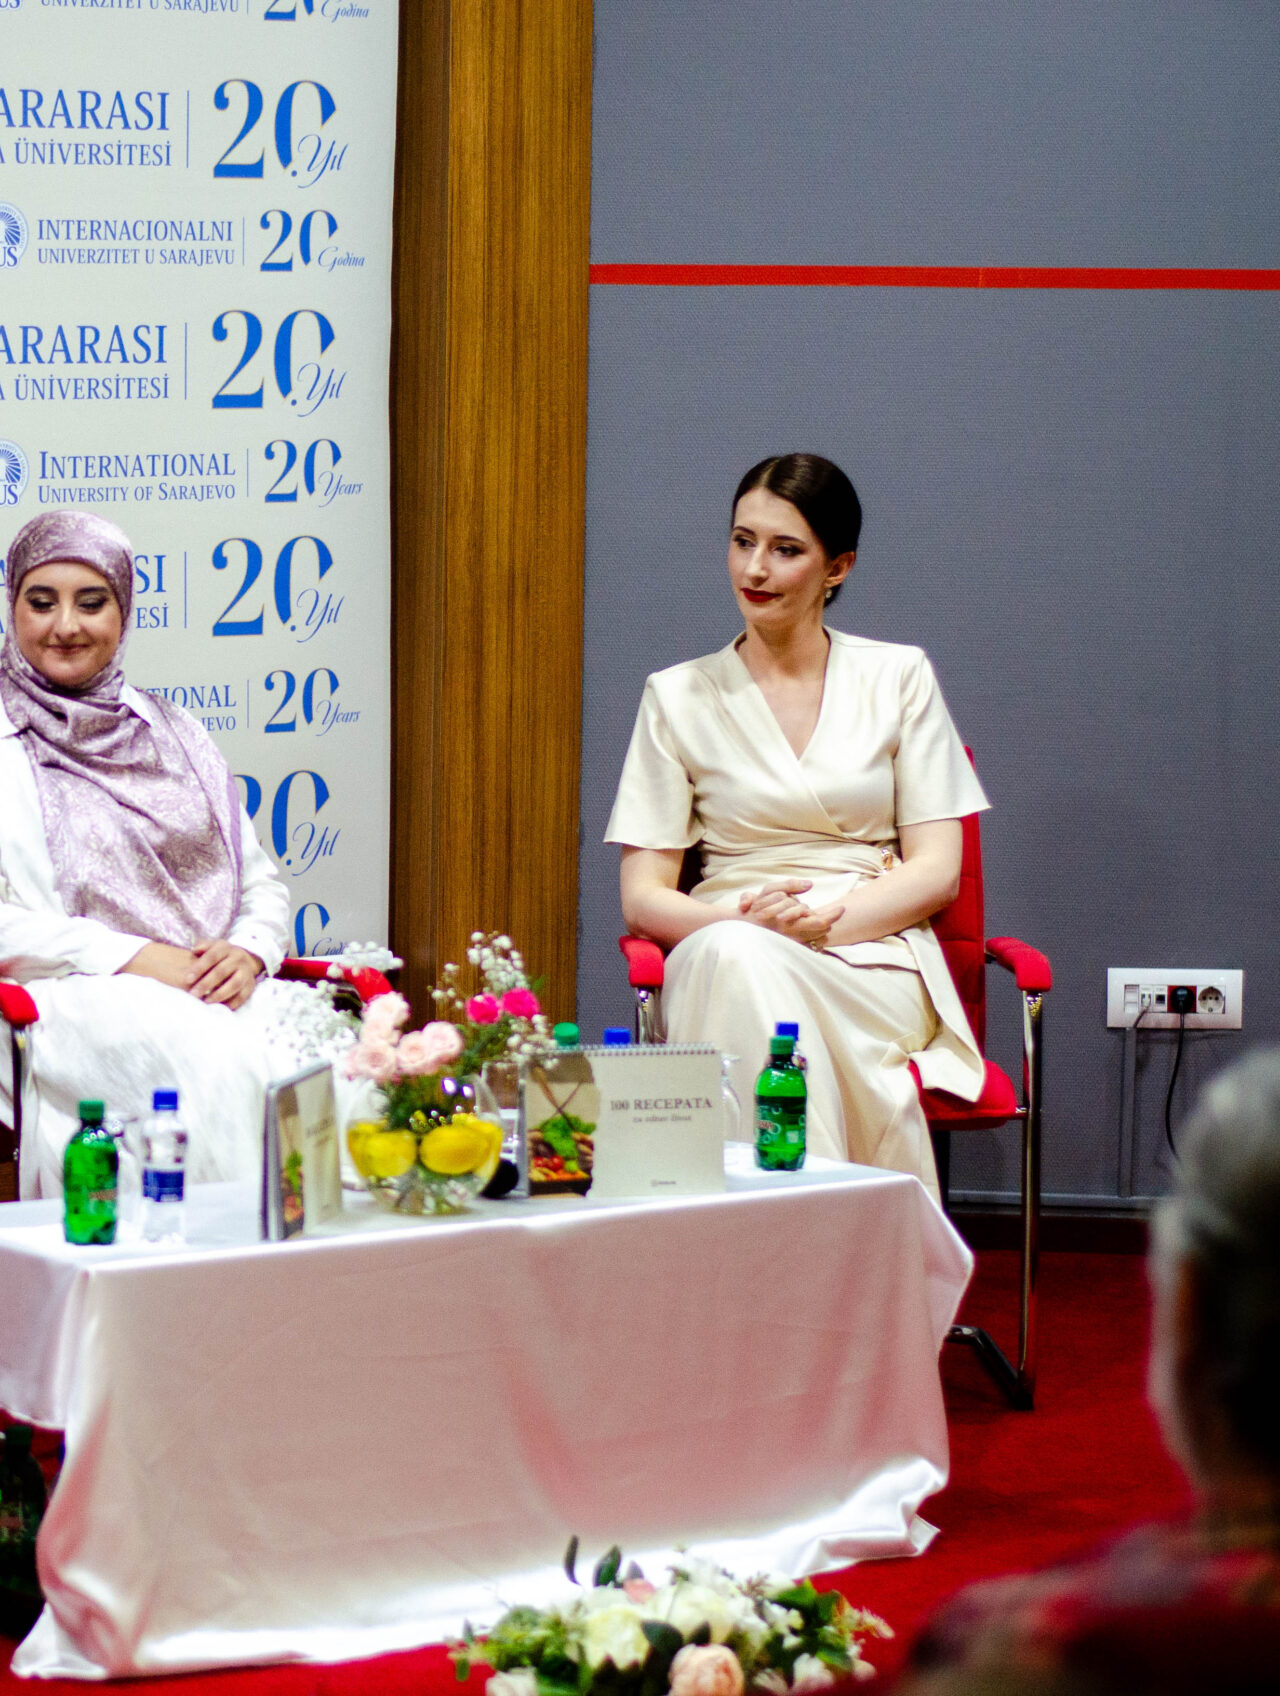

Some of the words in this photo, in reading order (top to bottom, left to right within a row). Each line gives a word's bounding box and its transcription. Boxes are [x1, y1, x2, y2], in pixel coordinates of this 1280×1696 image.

[14, 137, 172, 167] ÜNİVERSİTESİ
[38, 218, 232, 242] INTERNACIONALNI
[260, 210, 340, 272] 20
[317, 246, 366, 270] Godina
[38, 248, 140, 264] UNIVERZITET
[145, 248, 154, 264] U
[160, 248, 234, 267] SARAJEVU
[14, 373, 171, 402] ÜNİVERSİTESİ
[40, 450, 236, 480] INTERNATIONAL
[264, 439, 345, 504] 20
[317, 472, 363, 508] Years
[37, 484, 130, 504] UNIVERSITY
[134, 486, 154, 502] OF
[158, 481, 236, 503] SARAJEVO
[264, 668, 341, 735] 20
[317, 700, 361, 736] Years
[634, 1097, 712, 1110] RECEPATA
